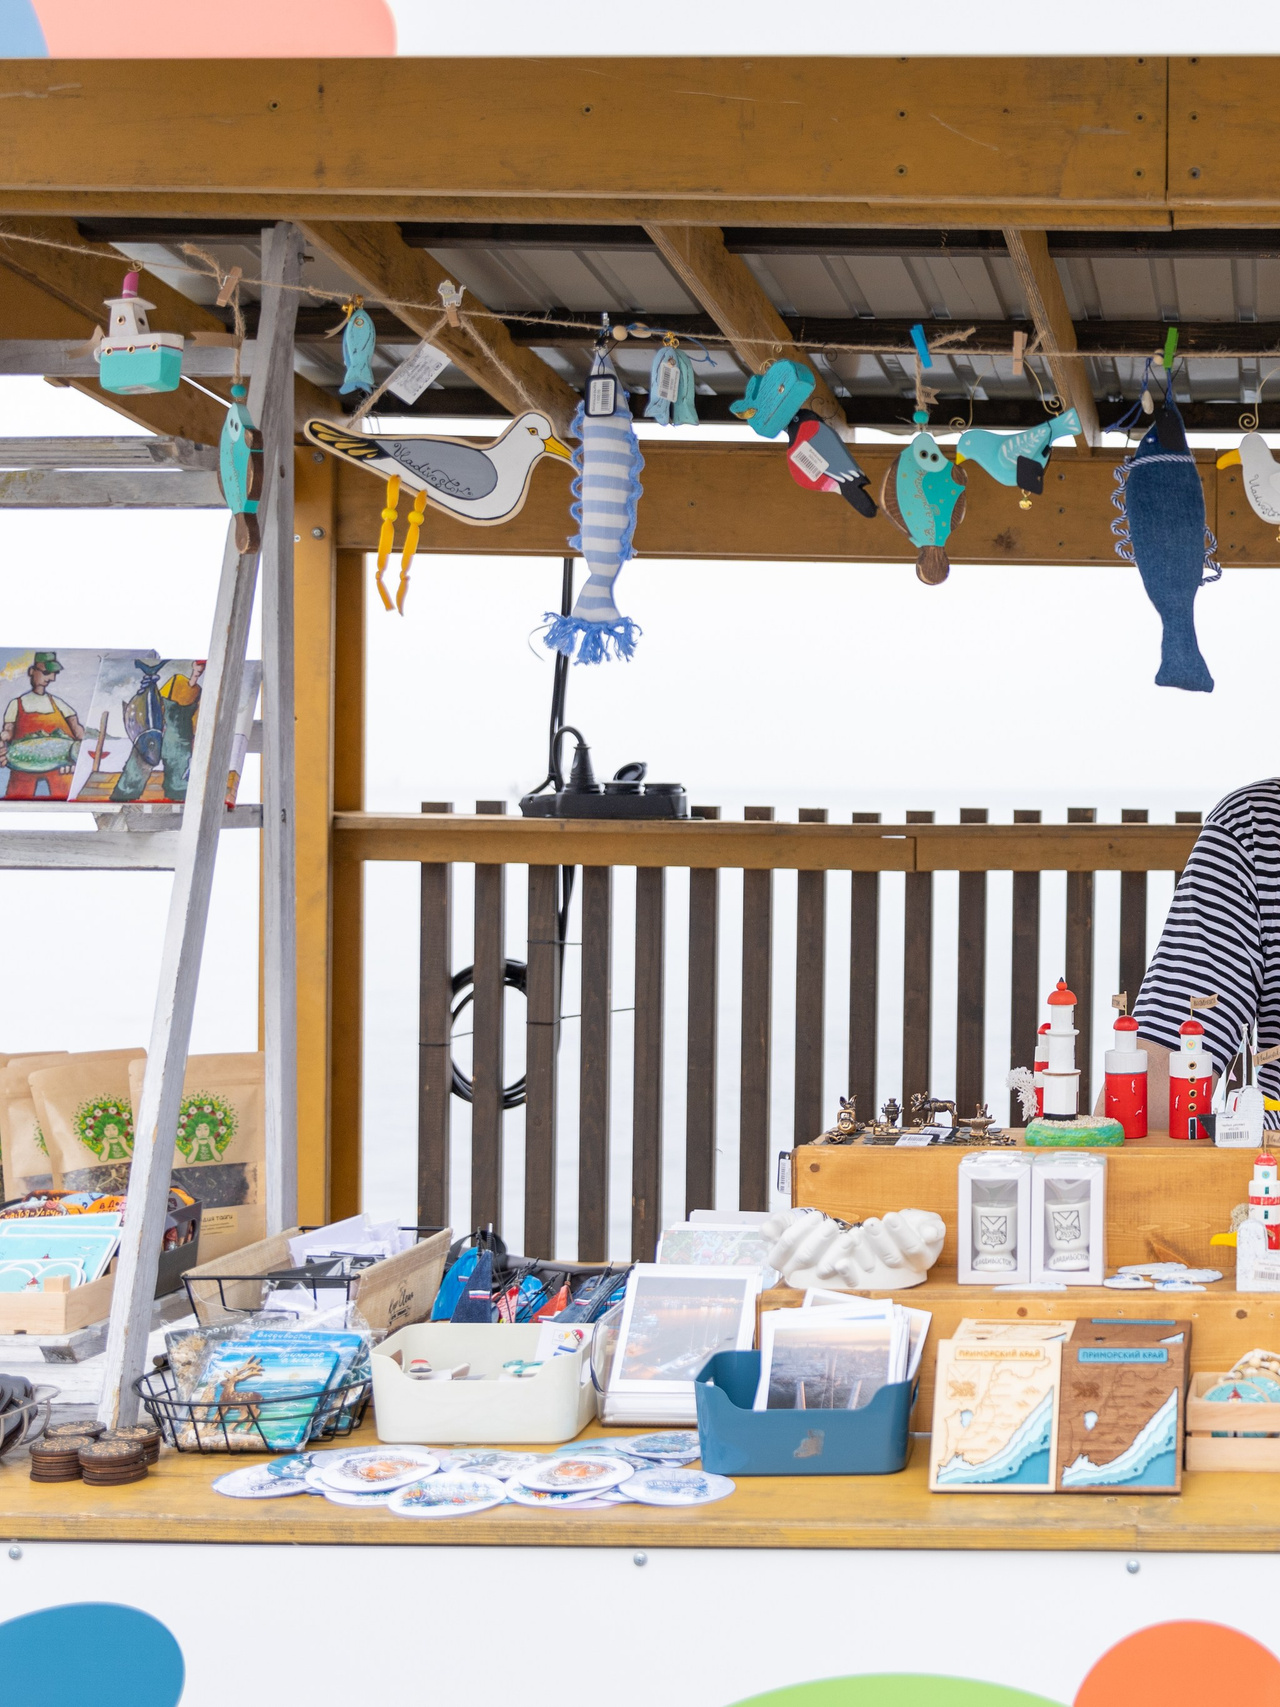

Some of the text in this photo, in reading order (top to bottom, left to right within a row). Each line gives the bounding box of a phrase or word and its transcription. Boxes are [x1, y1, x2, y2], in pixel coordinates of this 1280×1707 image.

[959, 1349, 1041, 1358] ПРИМОРСКИЙ КРАЙ
[1082, 1350, 1165, 1359] ПРИМОРСКИЙ КРАЙ
